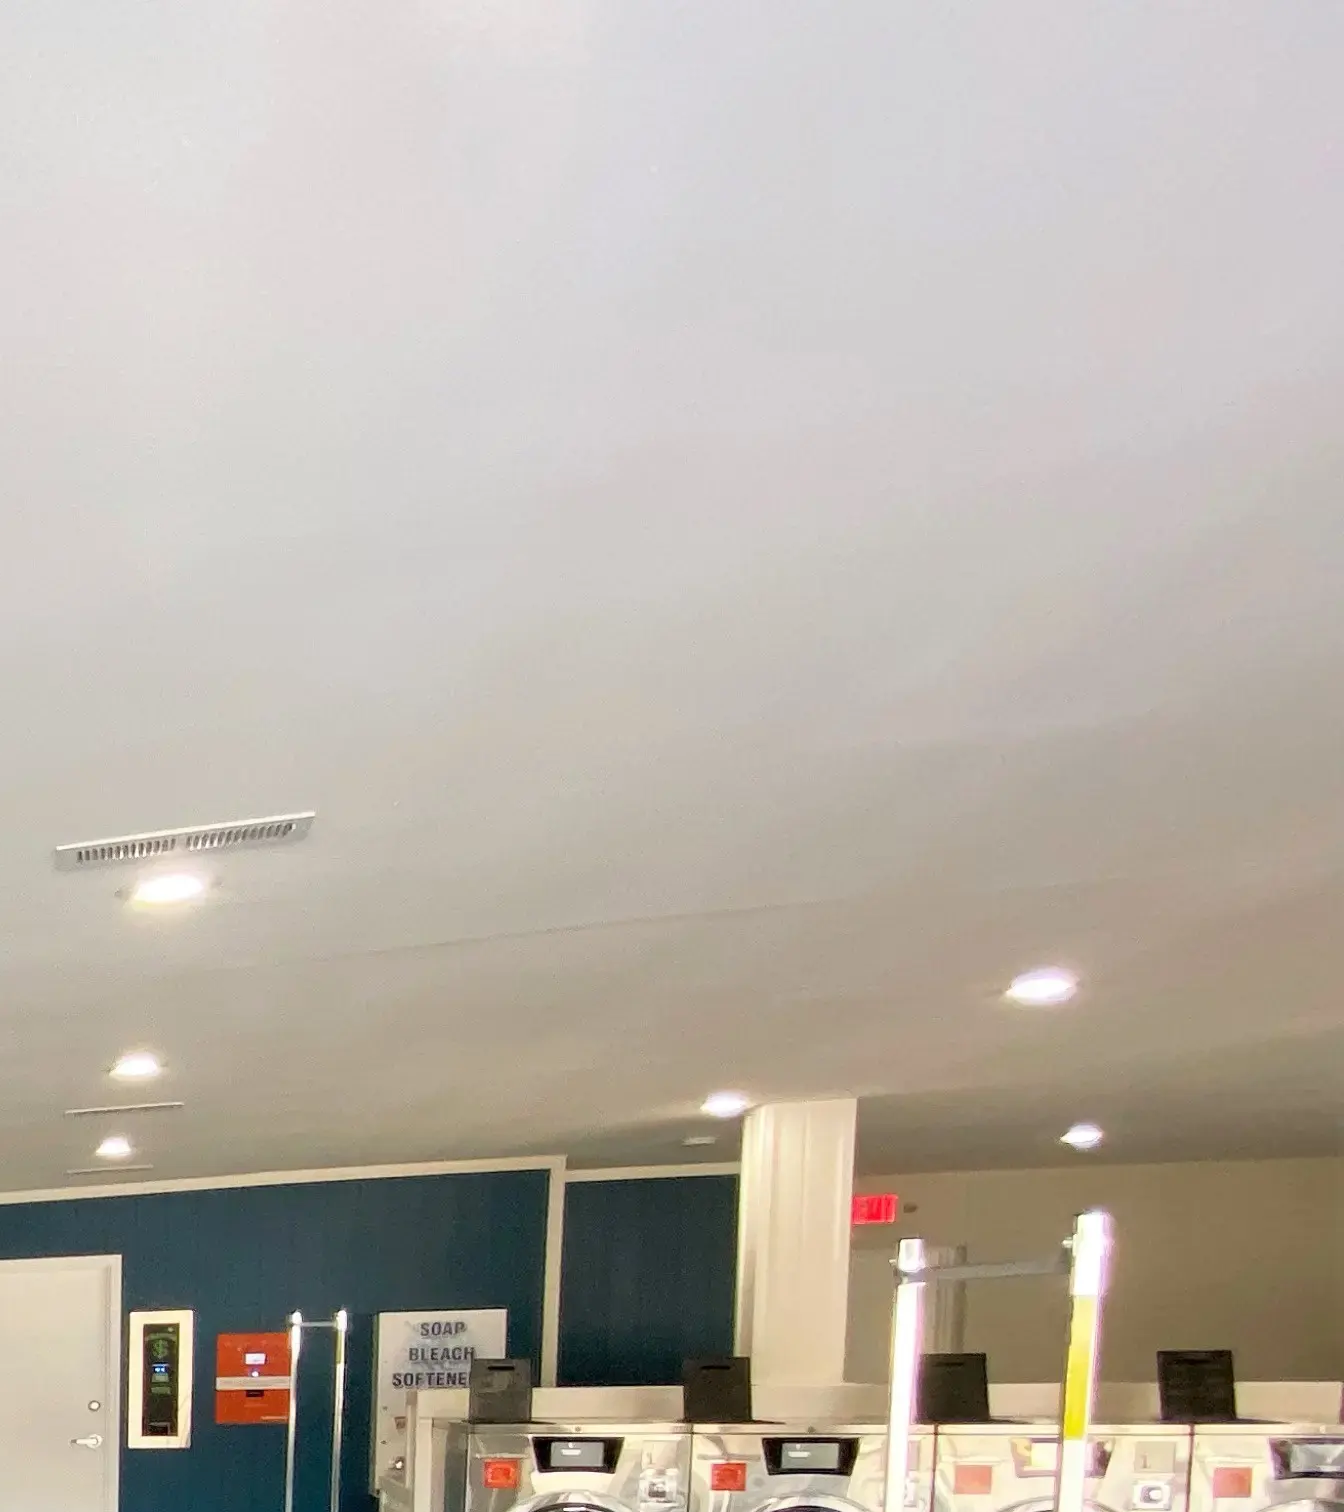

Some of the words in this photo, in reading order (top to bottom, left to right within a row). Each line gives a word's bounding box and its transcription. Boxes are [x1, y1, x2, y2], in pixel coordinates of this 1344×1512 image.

[420, 1321, 467, 1337] SOAP
[408, 1346, 475, 1362] BLEACH
[392, 1372, 471, 1387] SOFTENE
